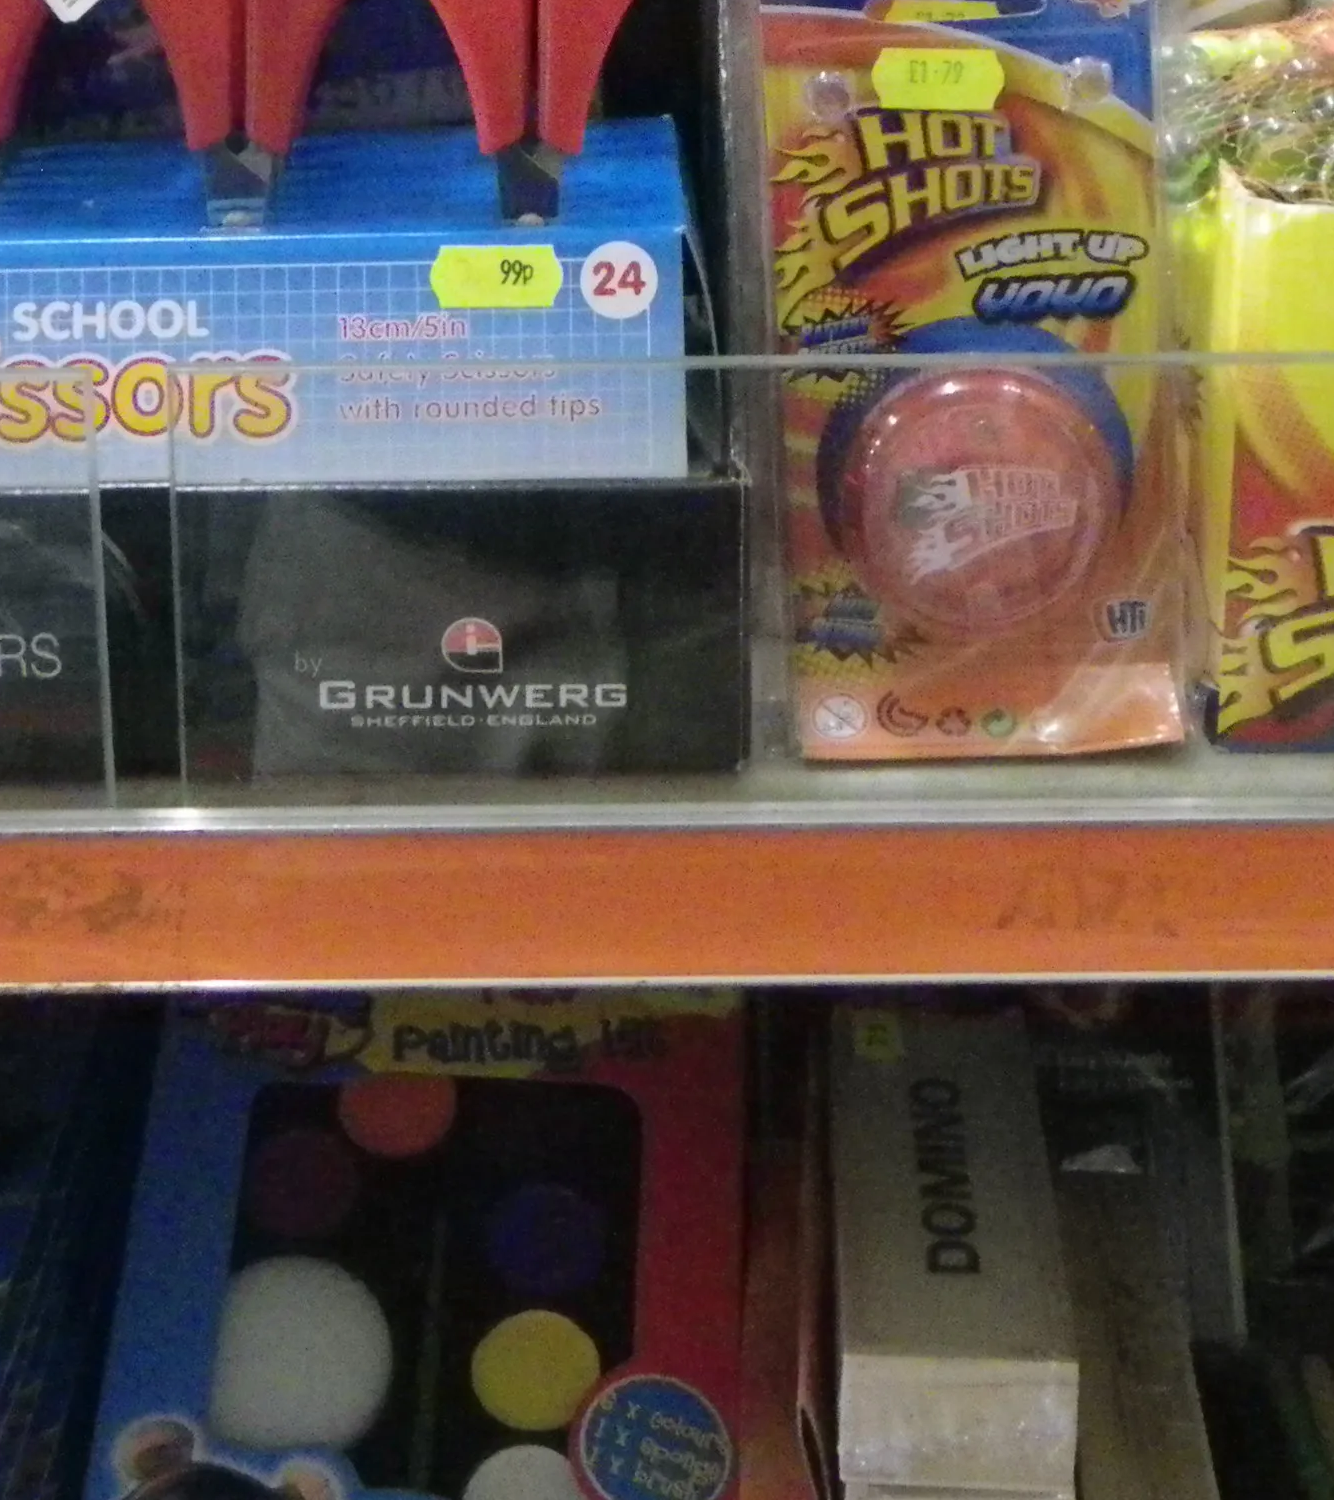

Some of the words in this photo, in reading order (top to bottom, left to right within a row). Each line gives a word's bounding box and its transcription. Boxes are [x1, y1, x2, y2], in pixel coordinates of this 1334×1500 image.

[856, 110, 1008, 171] HOT
[821, 162, 1036, 269] SHOTS
[499, 259, 534, 286] 99p
[592, 260, 646, 297] 24
[12, 299, 210, 342] SCHOOL
[339, 396, 401, 421] with
[413, 393, 538, 420] rounded
[549, 393, 601, 422] tips
[293, 651, 324, 676] by
[318, 679, 628, 710] GRUNWERG
[909, 1077, 982, 1277] DOMINO
